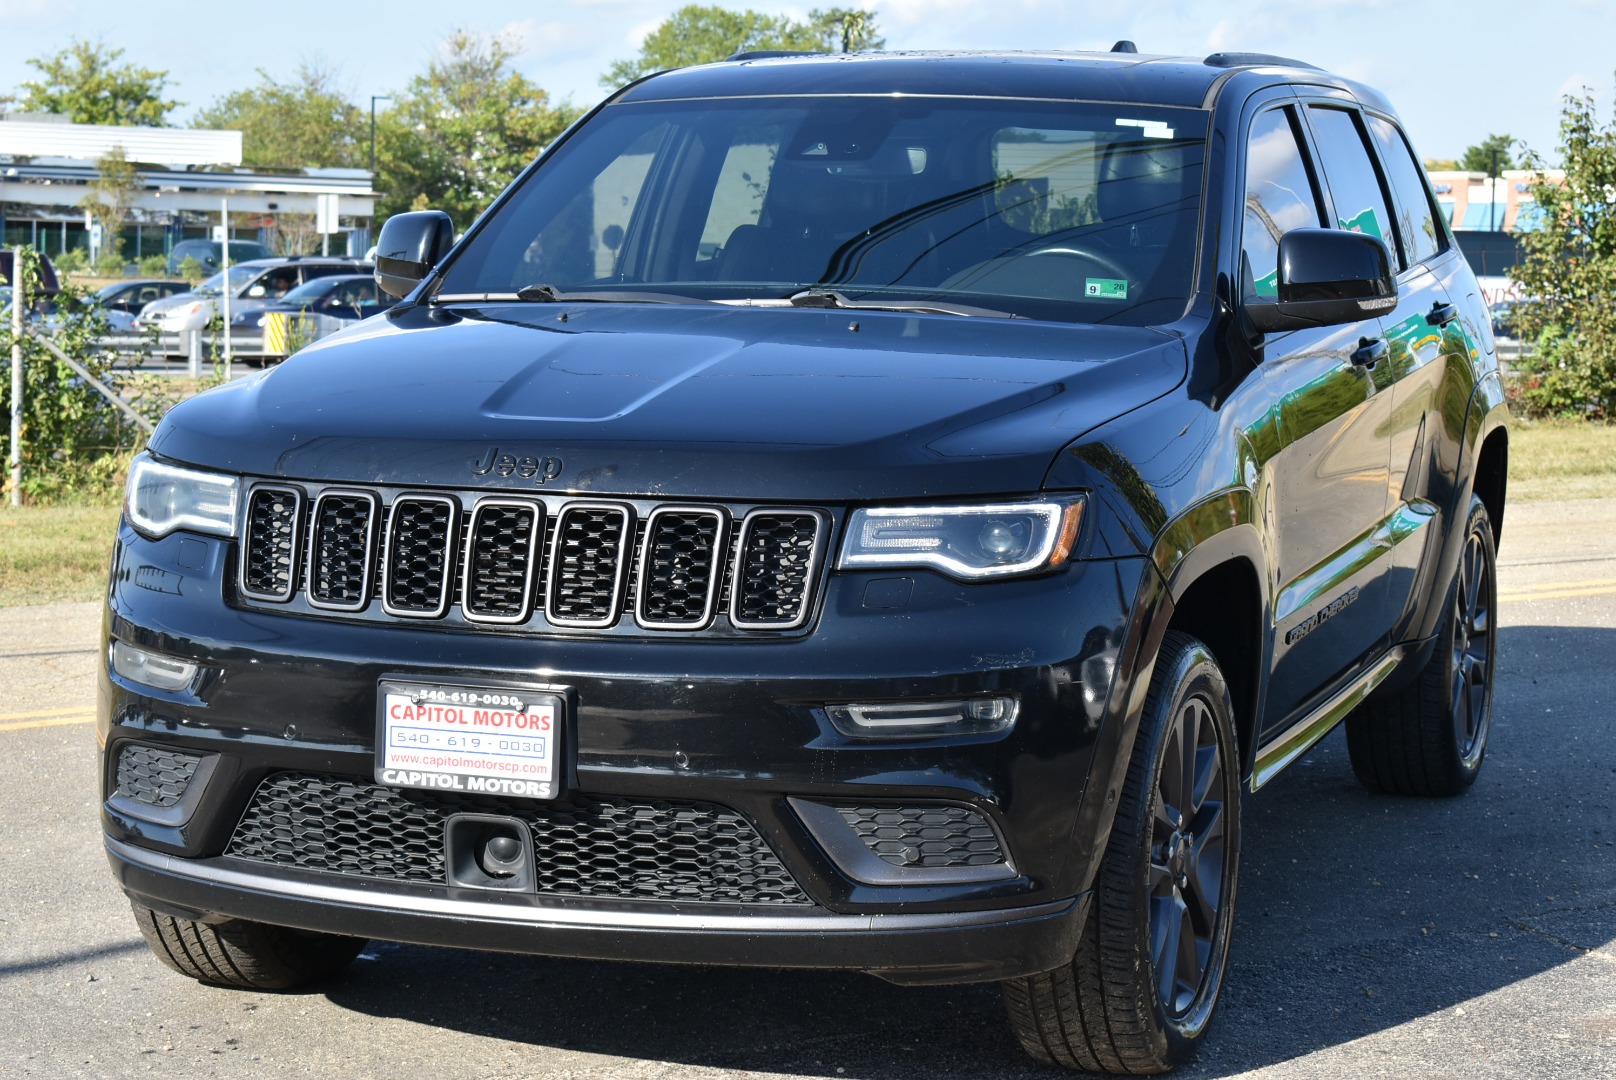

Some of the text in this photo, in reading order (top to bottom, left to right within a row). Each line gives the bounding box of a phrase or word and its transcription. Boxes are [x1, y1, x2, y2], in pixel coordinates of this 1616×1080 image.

[1089, 285, 1097, 294] 9
[470, 447, 563, 485] Jeep
[420, 689, 518, 707] 540-619-0030
[390, 704, 550, 731] CAPITOL MOTORS
[390, 753, 547, 774] www.capitolmotorscp.com
[382, 769, 551, 797] CAPITOL MOTORS
